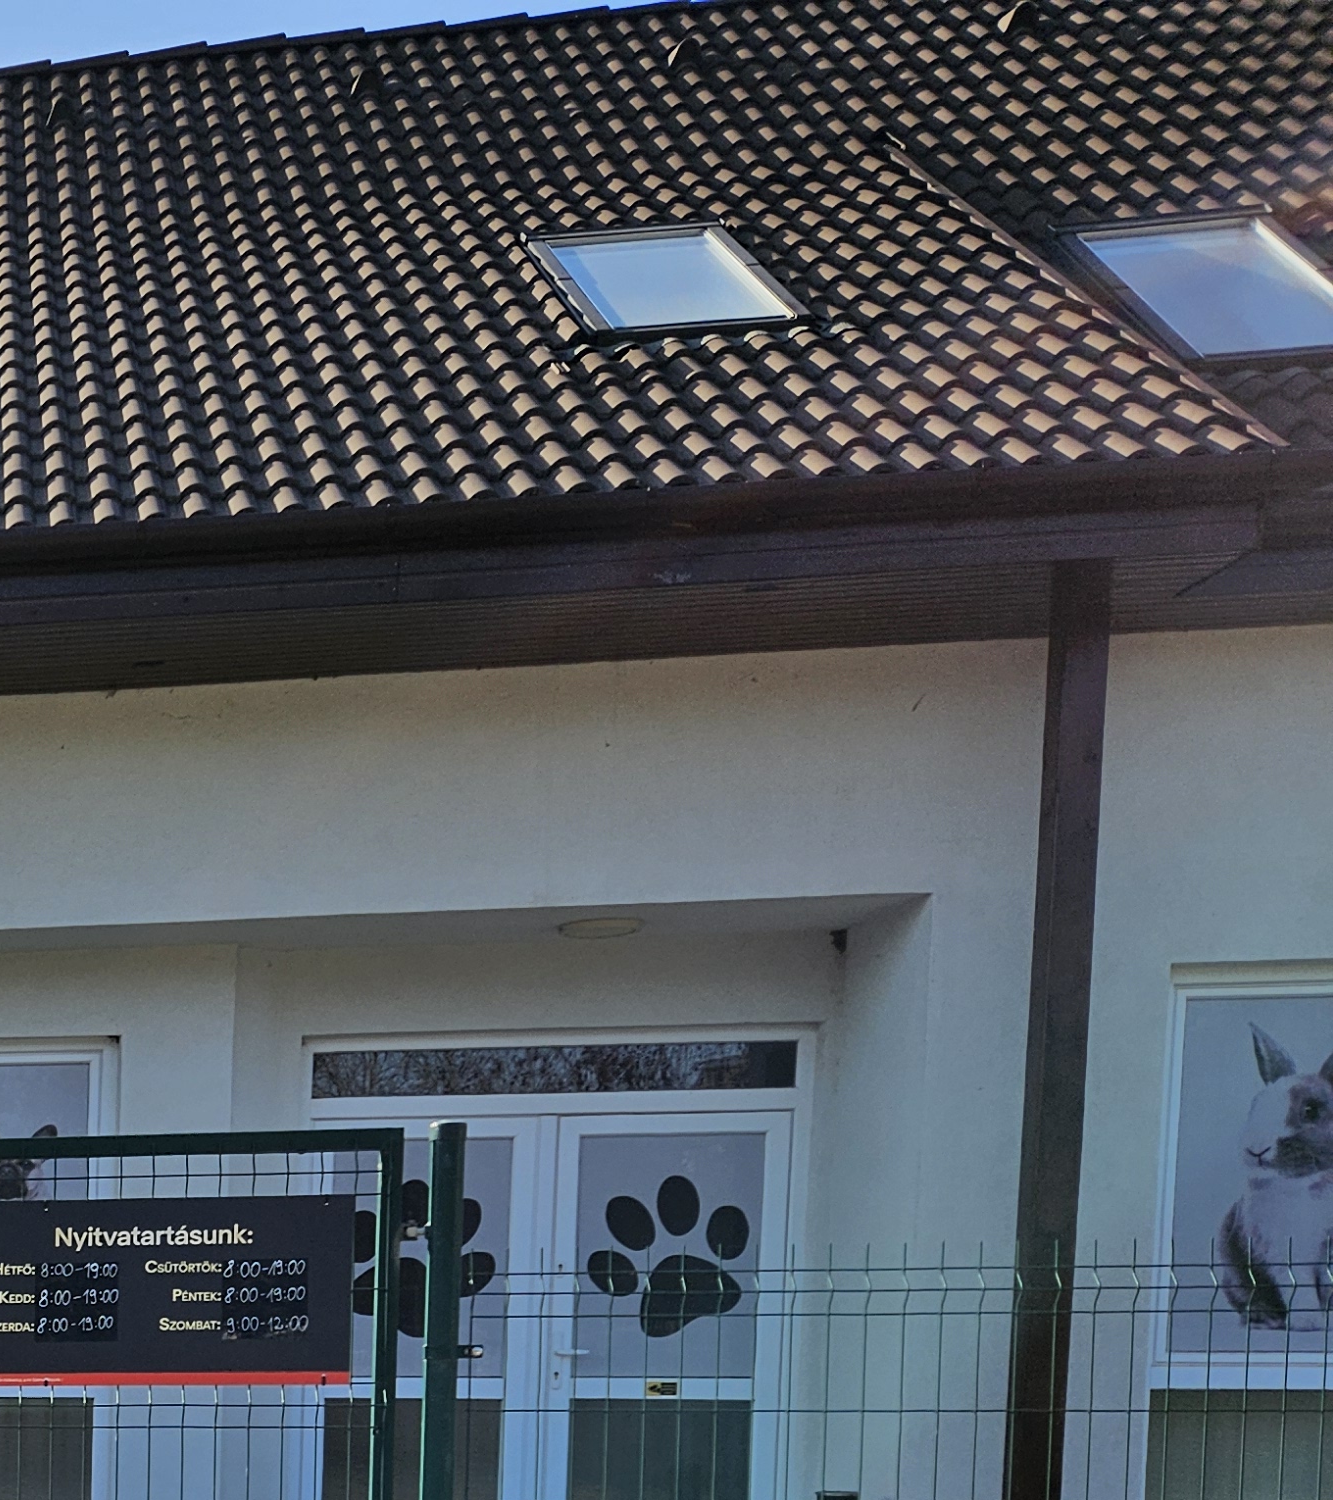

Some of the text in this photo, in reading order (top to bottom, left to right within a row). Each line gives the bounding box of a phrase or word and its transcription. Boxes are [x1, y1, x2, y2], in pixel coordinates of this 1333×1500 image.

[54, 1223, 254, 1252] Nyitvatartásunk:
[171, 1288, 222, 1302] PÉNTEK:
[158, 1317, 221, 1332] SZOMBAT:
